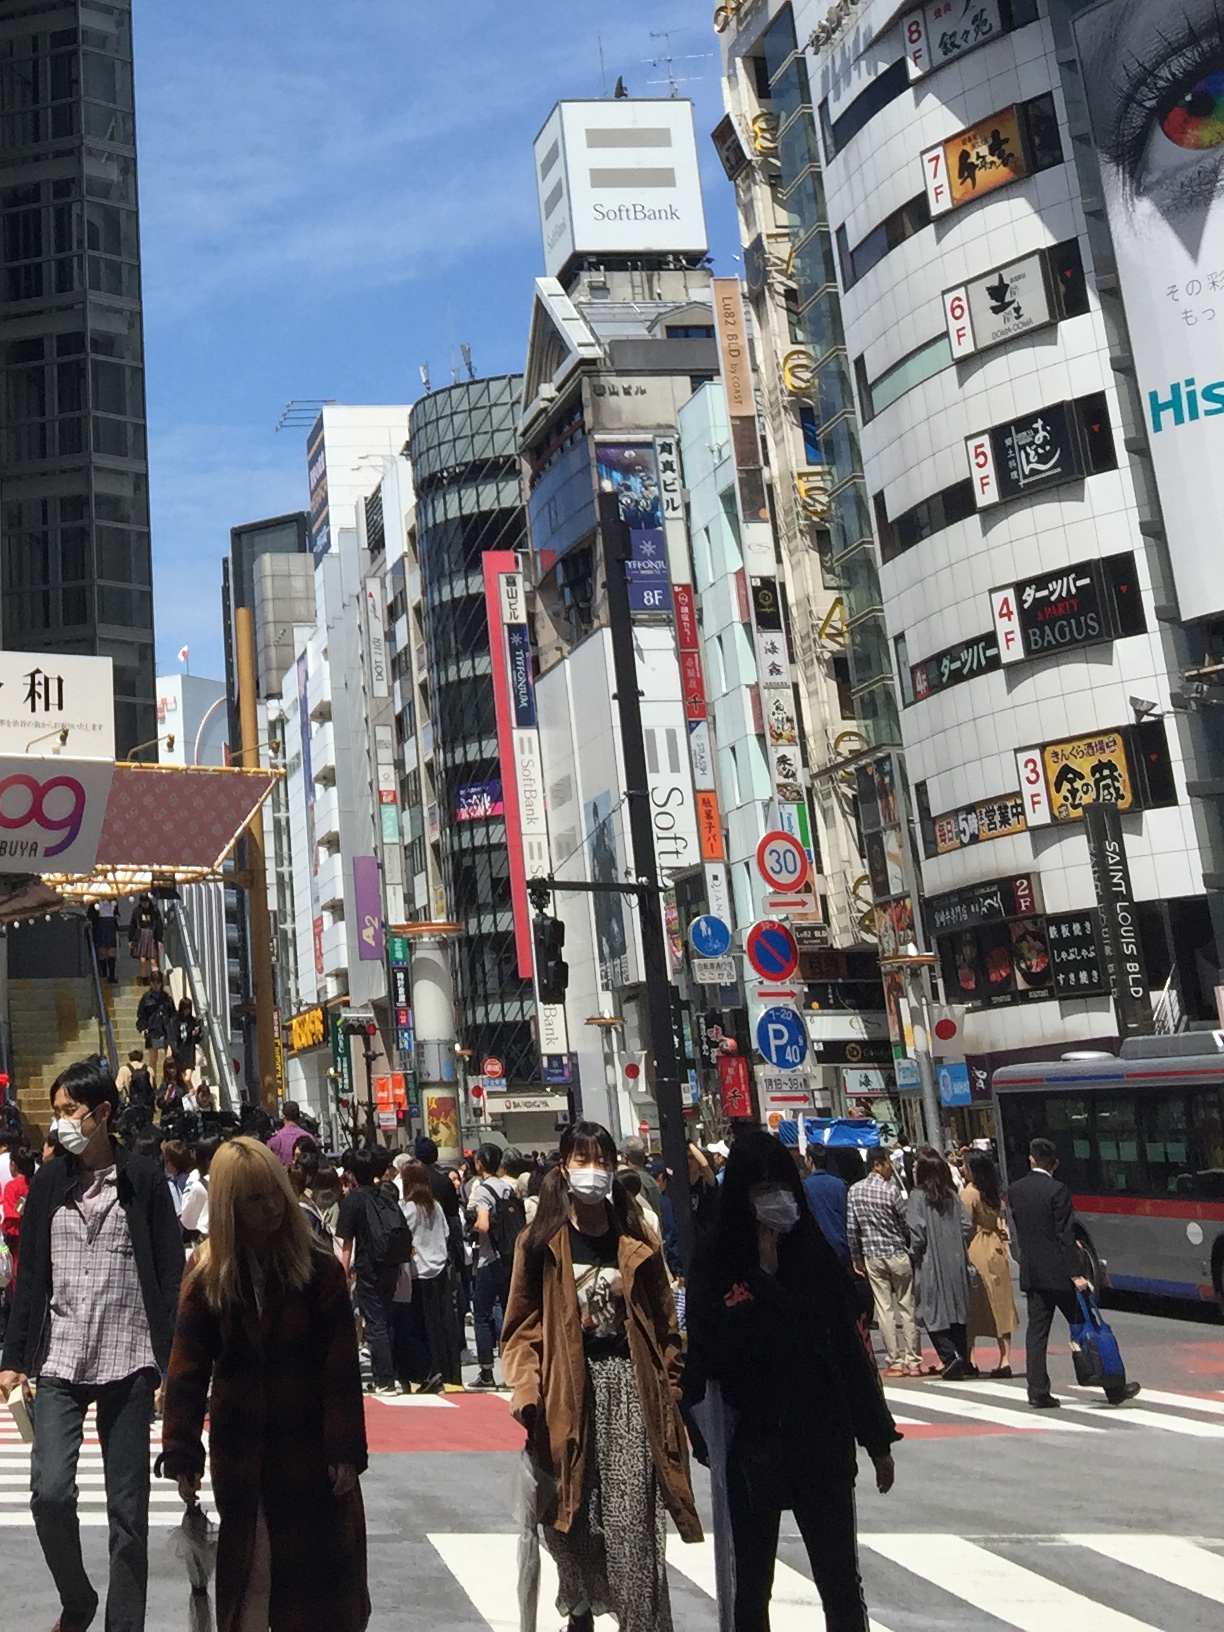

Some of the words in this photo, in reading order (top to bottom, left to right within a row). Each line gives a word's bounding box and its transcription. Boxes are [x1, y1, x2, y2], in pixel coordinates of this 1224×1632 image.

[593, 203, 681, 221] SoftBank
[721, 296, 736, 326] Lu82
[726, 333, 741, 358] BLD
[643, 590, 664, 606] 8F
[1022, 573, 1091, 610] ダーツバー
[1028, 613, 1100, 651] BAGUS
[940, 640, 999, 685] ダーツバー
[520, 759, 539, 826] SoftBank
[1053, 758, 1126, 810] 金の蔵
[768, 848, 798, 875] 30
[1105, 840, 1126, 895] SAINT
[362, 915, 379, 947] A2
[1116, 902, 1137, 956] LOUIS
[1126, 962, 1143, 998] BLD
[767, 1023, 789, 1063] P
[784, 1045, 801, 1063] 40
